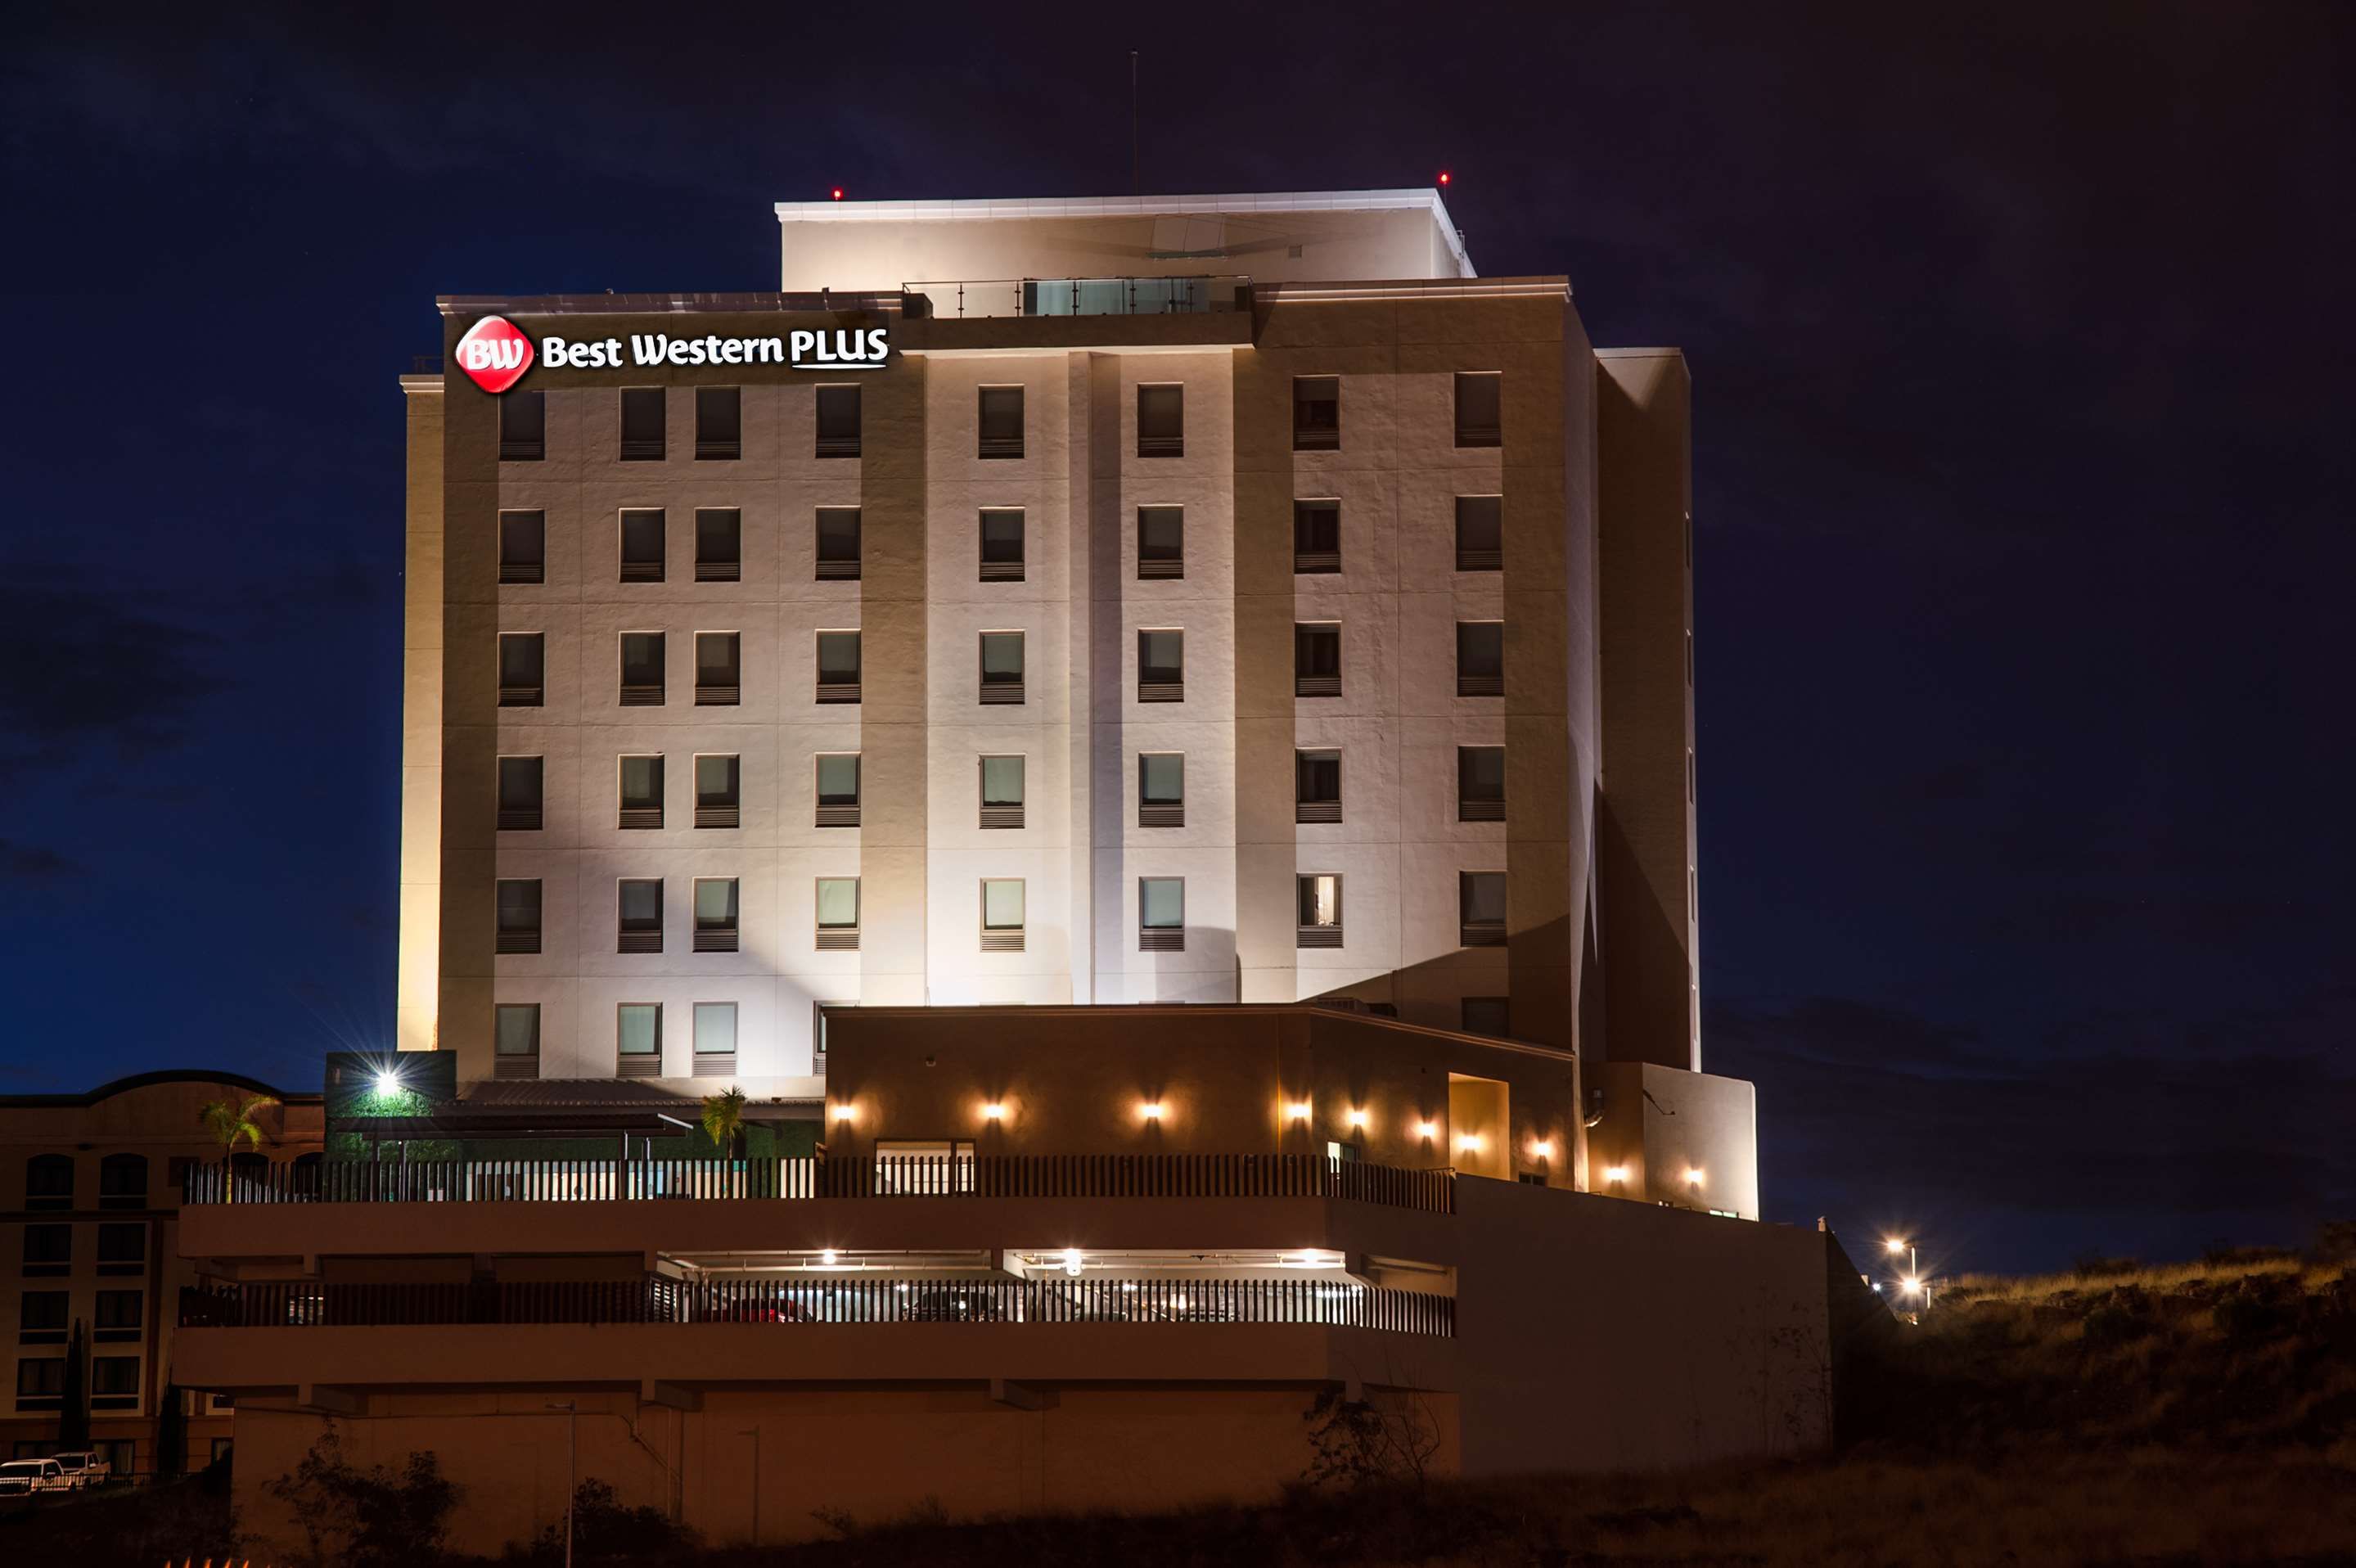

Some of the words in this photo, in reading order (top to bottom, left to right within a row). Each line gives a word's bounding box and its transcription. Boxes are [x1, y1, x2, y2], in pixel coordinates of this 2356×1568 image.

[466, 338, 525, 370] BW
[543, 336, 624, 367] Best
[631, 333, 785, 365] Western
[791, 329, 889, 362] PLUS
